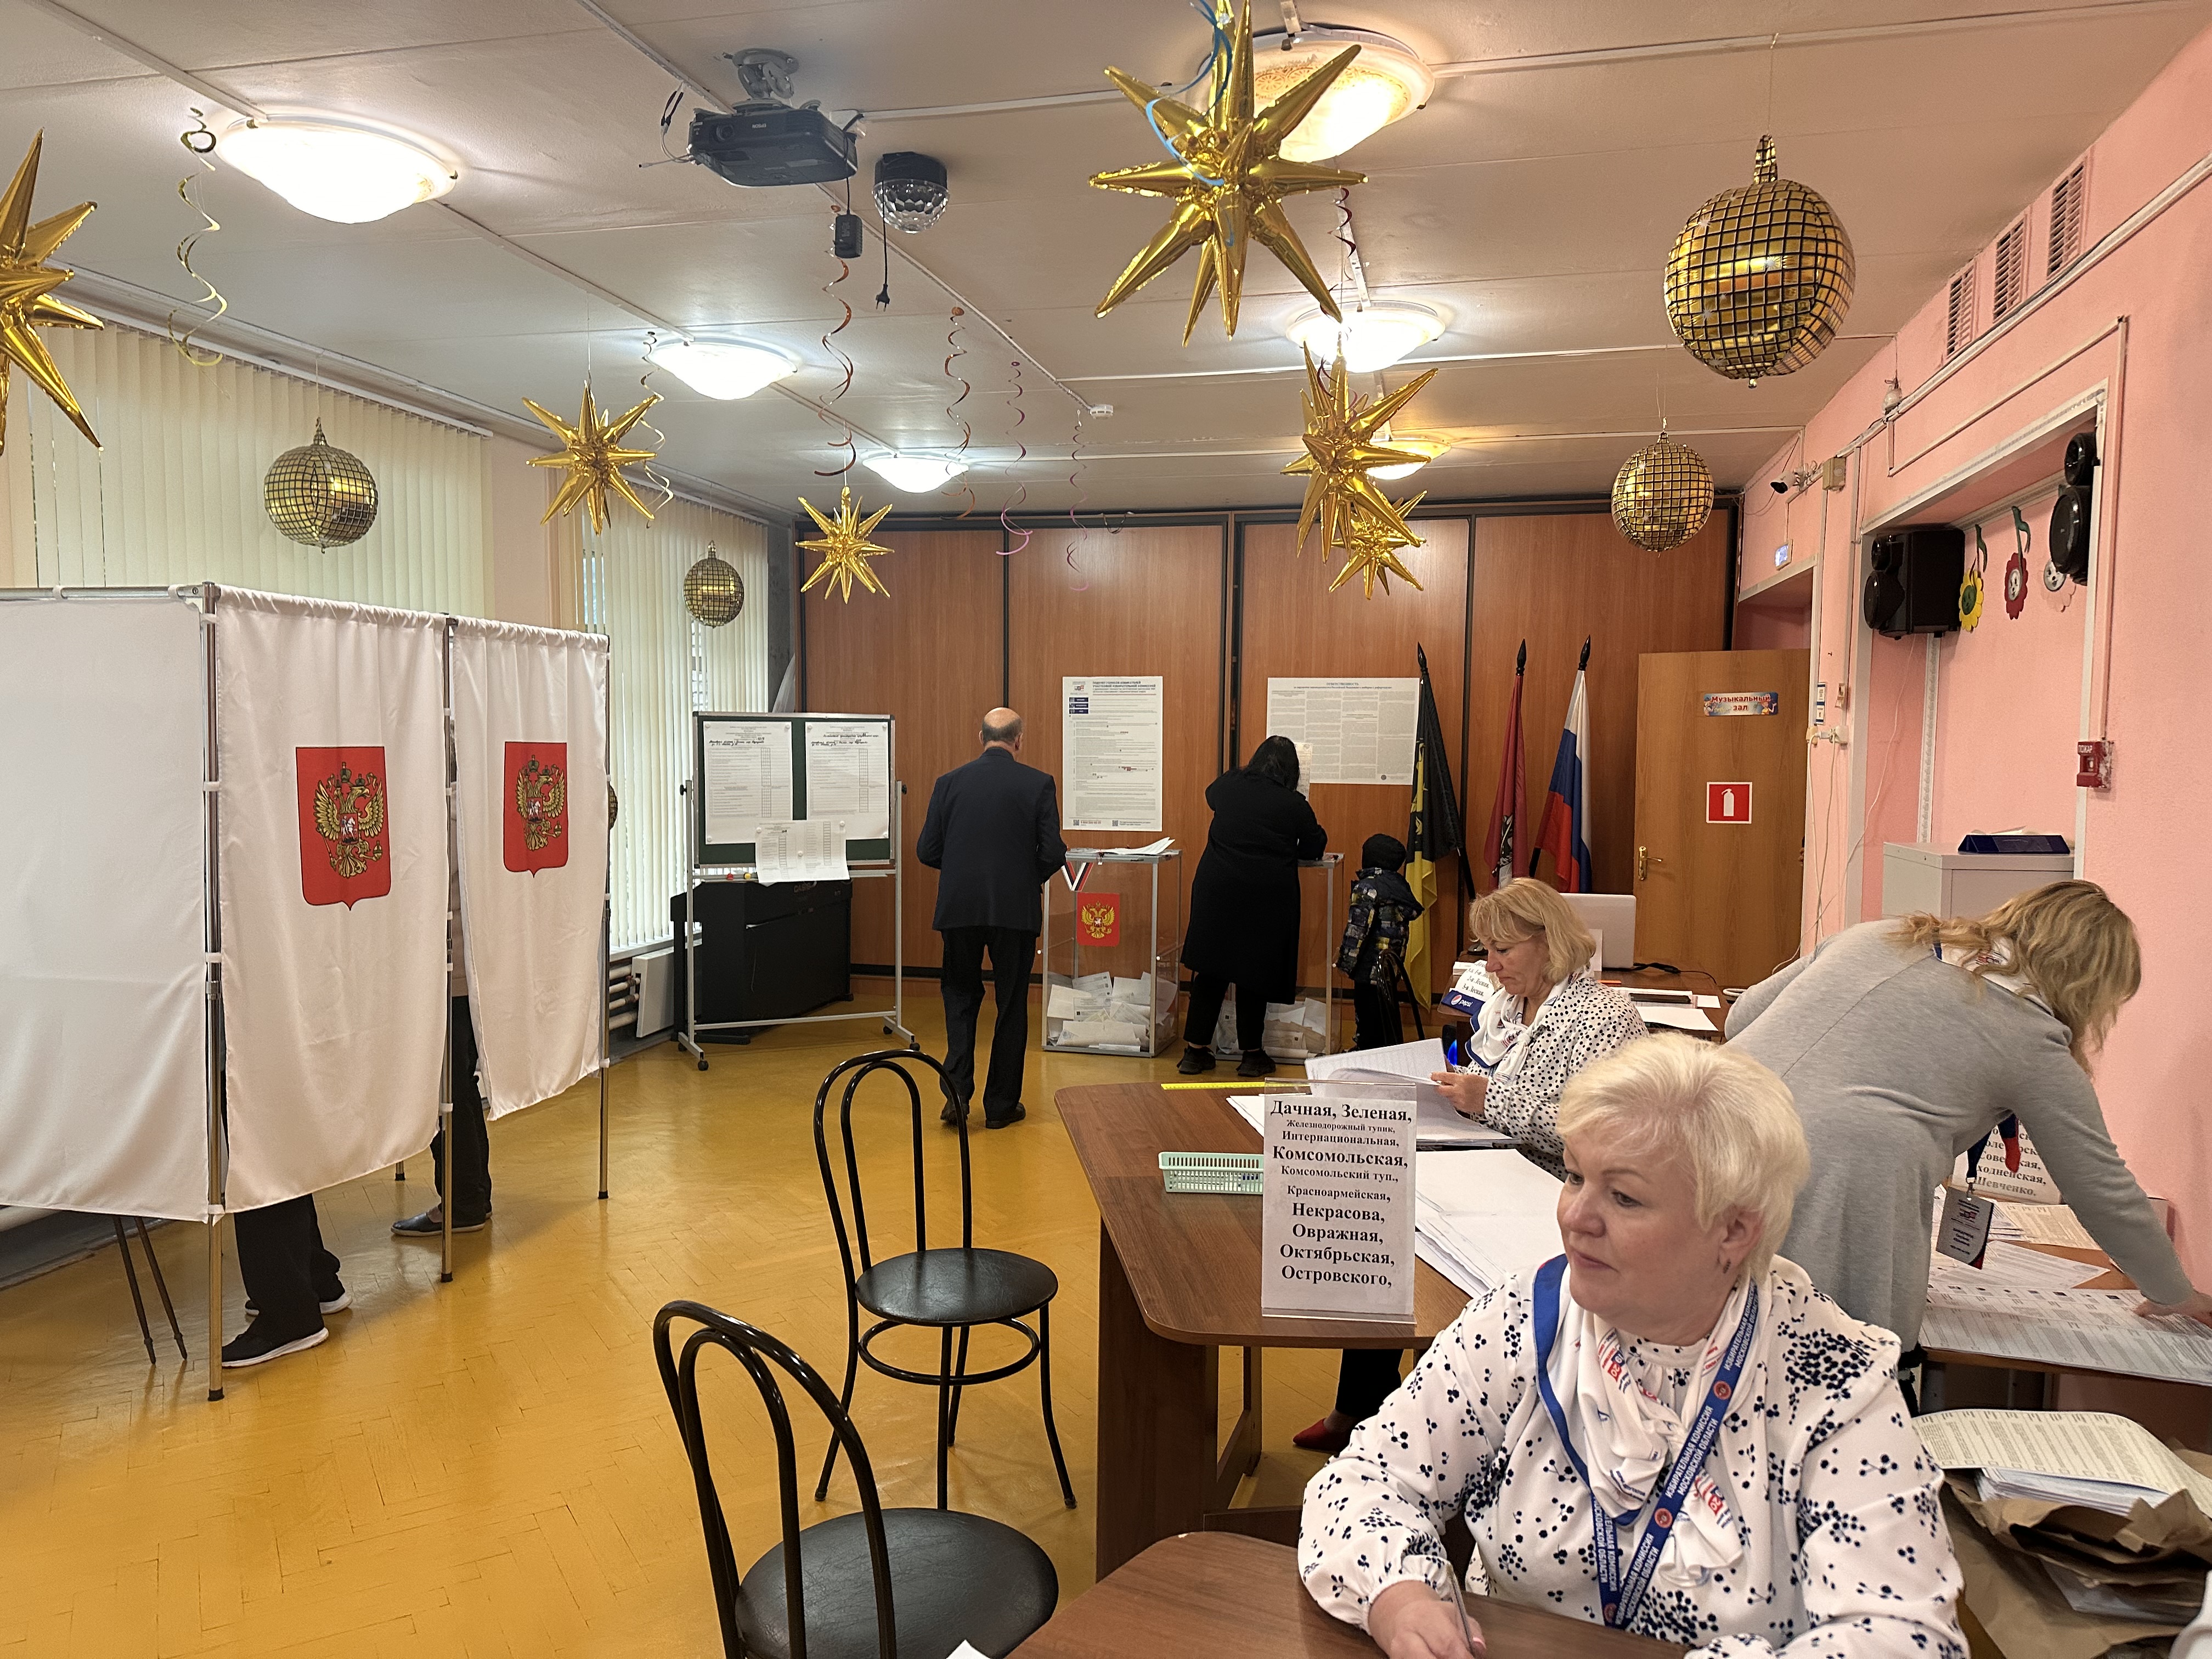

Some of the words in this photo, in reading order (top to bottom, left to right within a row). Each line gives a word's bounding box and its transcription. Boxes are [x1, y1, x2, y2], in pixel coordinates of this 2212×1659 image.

[1711, 693, 1771, 703] Музыкальный
[1271, 1101, 1336, 1119] Дачная,
[1342, 1104, 1412, 1123] Зеленая,
[1286, 1120, 1365, 1131] Железнодорожный
[1282, 1131, 1399, 1147] Интернациональная,
[1273, 1146, 1408, 1168] Комсомольская,
[1980, 1150, 2041, 1170] овекая,
[1281, 1166, 1369, 1180] Комсомольский
[1373, 1173, 1398, 1183] туп.,
[1977, 1165, 2046, 1184] ходненская,
[1287, 1186, 1390, 1202] Красноармейская,
[1293, 1203, 1385, 1223] Некрасова,
[1293, 1224, 1383, 1244] Овражная,
[1280, 1244, 1395, 1266] Октябрьская,
[1282, 1266, 1392, 1287] Островского,
[1724, 1317, 1747, 1371] ИЗБИРАТЕЛЬНАЯ
[1735, 1323, 1753, 1368] МОСКОВСКОЙ
[1611, 1364, 1620, 1377] 20
[1665, 1442, 1696, 1498] ИЗБИРАТЕЛЬНАЯ
[1690, 1405, 1713, 1443] КОМИССИЯ
[1677, 1447, 1704, 1496] МОСКОВСКОЙ
[1699, 1418, 1718, 1450] ОБЛАСТИ
[1710, 1497, 1721, 1510] 20
[1594, 1498, 1607, 1547] ОСКОВСКОЙ
[1598, 1549, 1607, 1583] ОБЛАСТИ
[1607, 1550, 1617, 1592] КОМИССИЯ
[1615, 1570, 1638, 1624] ИЗБИРАТЕЛЬНАЯ
[1633, 1532, 1654, 1573] КОМИССИЯ
[1625, 1577, 1647, 1618] МОСКОВСКОЙ
[1641, 1546, 1659, 1578] ОБЛАСТИ
